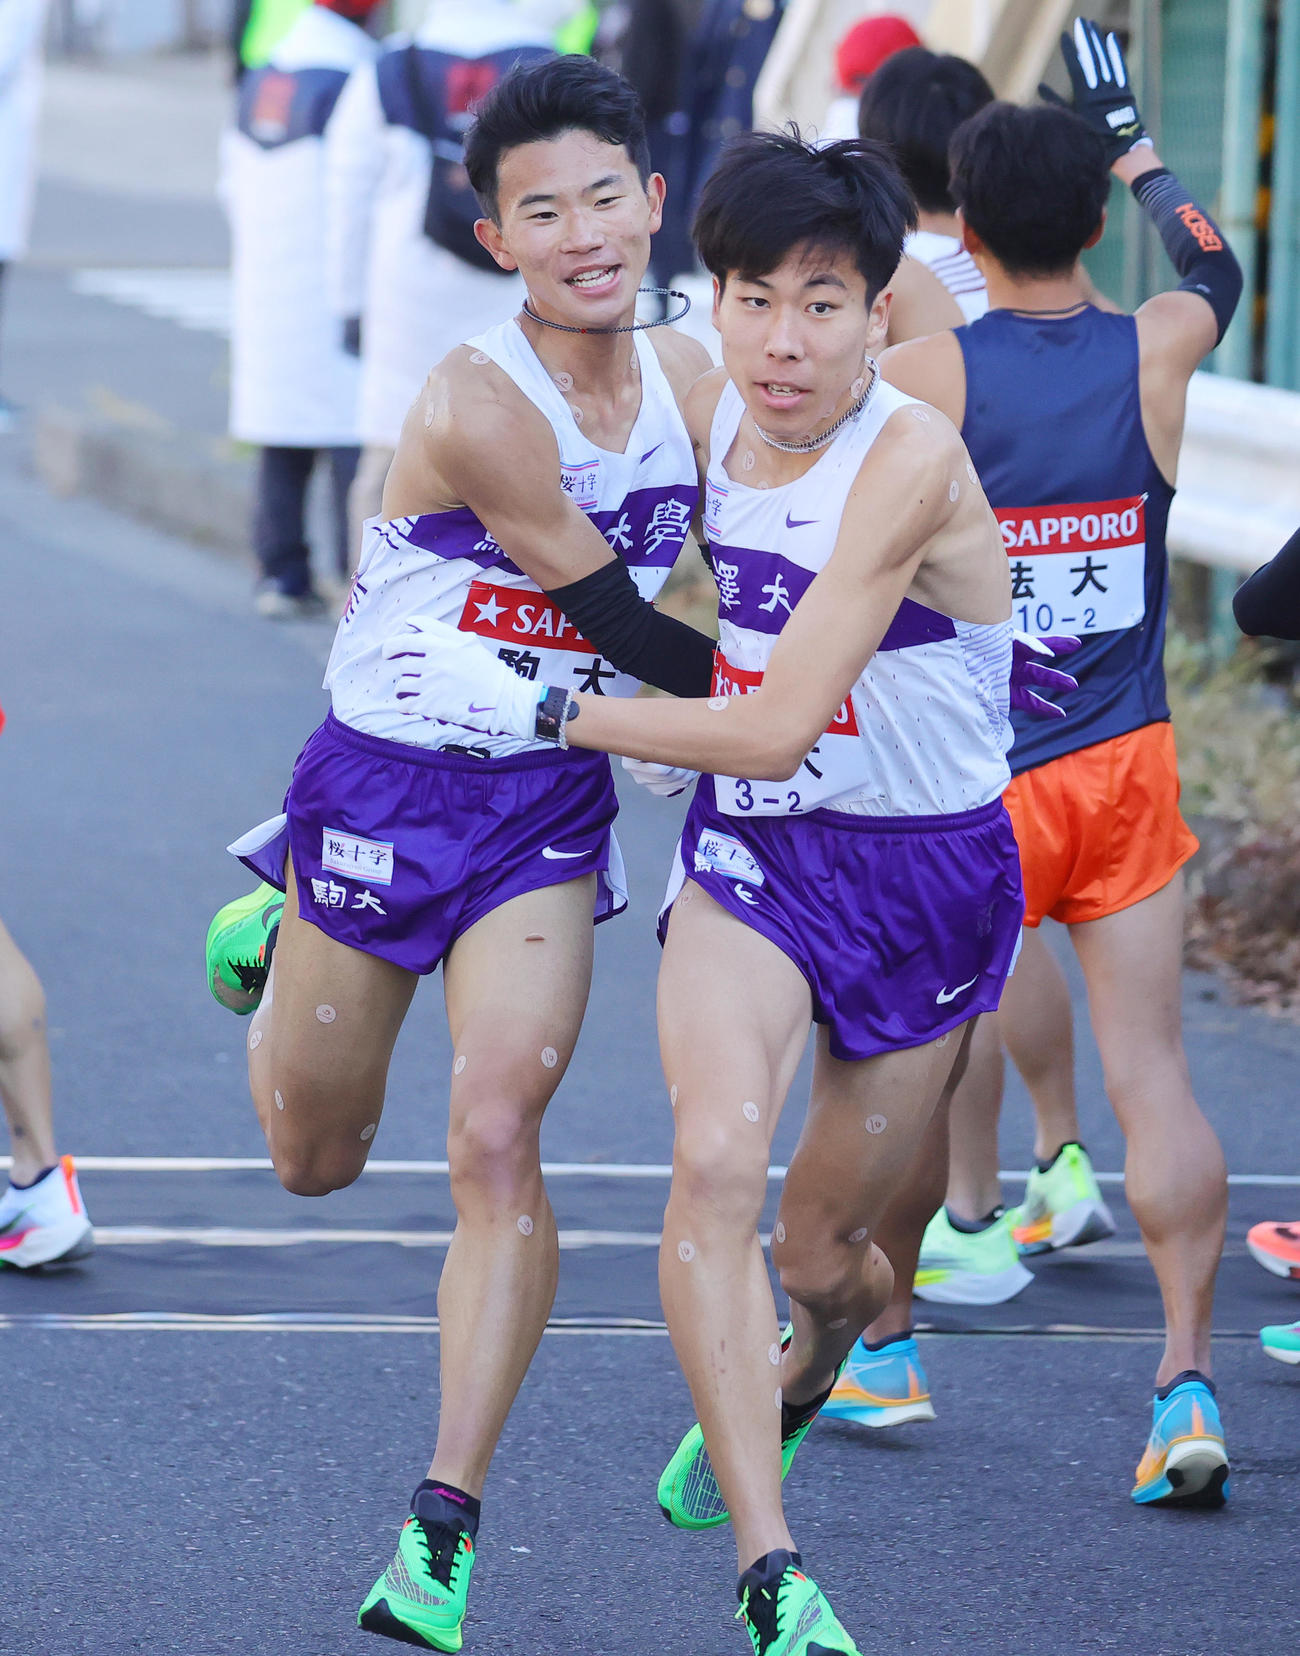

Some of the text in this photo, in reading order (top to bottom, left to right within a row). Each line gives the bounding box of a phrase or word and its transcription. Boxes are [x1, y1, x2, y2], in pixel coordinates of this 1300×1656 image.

[1000, 508, 1138, 548] SAPPORO
[328, 839, 388, 866] 桜十字
[311, 877, 388, 916] 駒大
